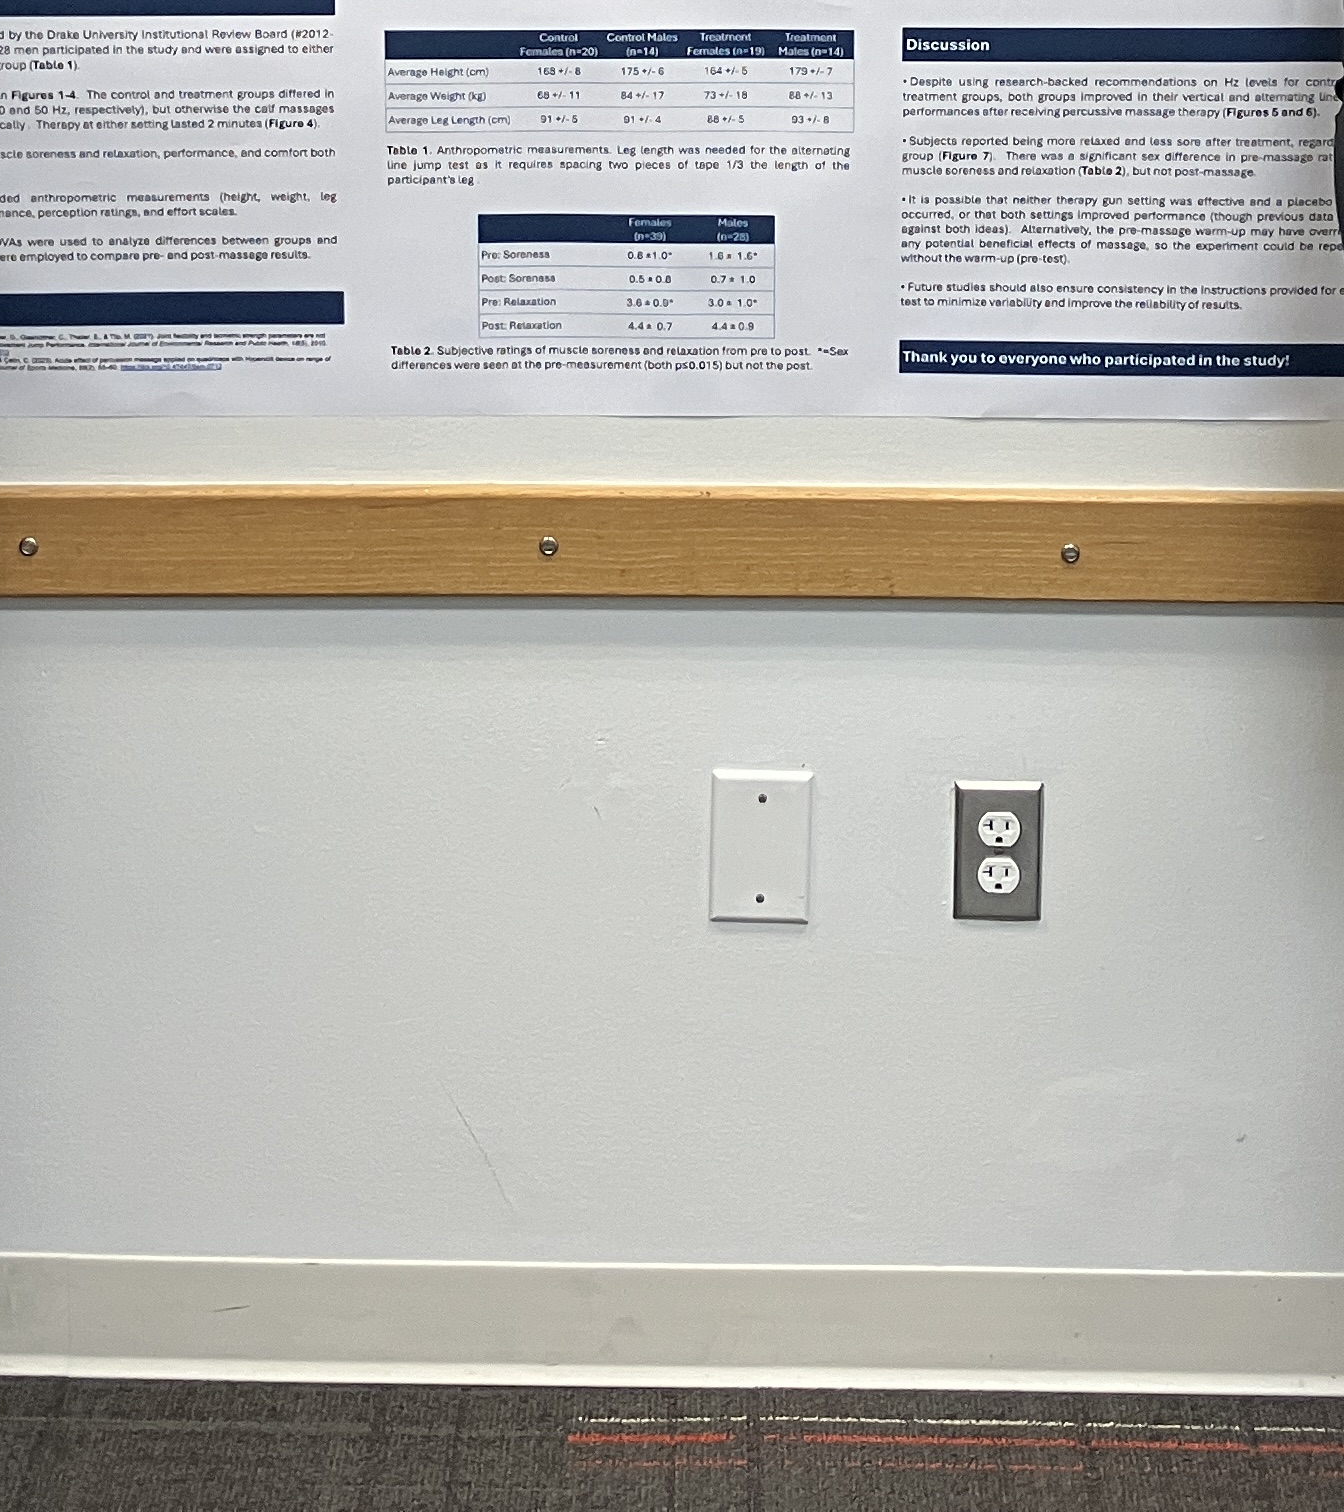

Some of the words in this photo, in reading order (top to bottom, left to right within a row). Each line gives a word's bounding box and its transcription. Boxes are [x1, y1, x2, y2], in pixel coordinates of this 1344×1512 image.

[539, 32, 578, 42] Control
[606, 32, 645, 42] Control
[647, 32, 678, 42] Males
[699, 32, 751, 42] Treatment
[784, 32, 837, 42] Treatment
[906, 38, 989, 51] Discussion
[387, 67, 428, 78] Average
[430, 67, 464, 78] Height
[465, 66, 489, 78] (cm)
[30, 192, 116, 204] anthropometric
[126, 193, 210, 202] measurements
[320, 191, 337, 203] leg
[900, 297, 921, 306] test
[923, 297, 935, 306] to
[936, 296, 987, 307] minimize
[988, 297, 1042, 309] variability
[1044, 297, 1065, 307] and
[1067, 297, 1112, 310] improve
[1114, 298, 1132, 309] the
[1134, 298, 1187, 311] reliability
[1187, 299, 1199, 309] of
[1201, 299, 1242, 310] results.
[902, 350, 947, 363] Thank
[950, 353, 977, 366] you
[980, 352, 996, 364] to
[998, 354, 1067, 367] everyone
[1069, 352, 1101, 365] who
[1104, 353, 1195, 368] participated
[1198, 353, 1212, 366] in
[1215, 354, 1240, 366] the
[1243, 354, 1289, 368] study!
